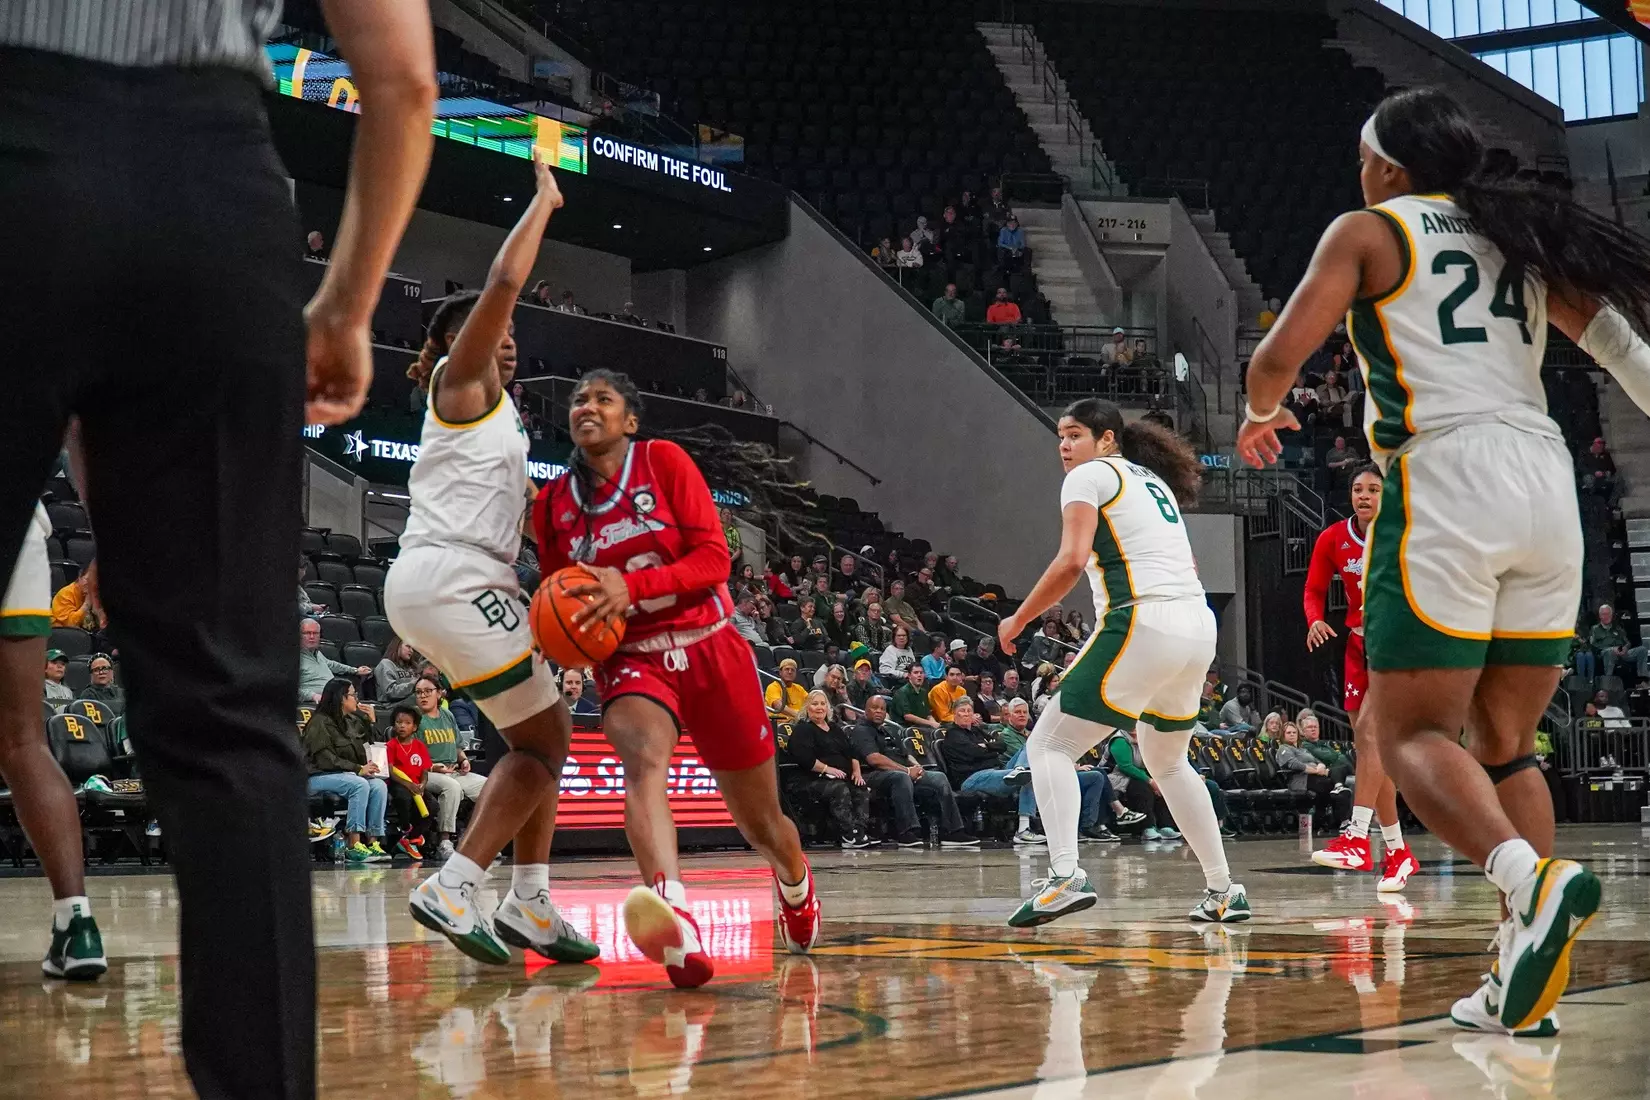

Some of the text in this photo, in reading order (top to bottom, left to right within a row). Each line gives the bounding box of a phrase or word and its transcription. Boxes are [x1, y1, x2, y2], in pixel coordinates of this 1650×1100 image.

[593, 136, 732, 193] CONFIRM THE FOUL.
[1098, 217, 1117, 229] 217
[1127, 218, 1147, 230] 216
[403, 284, 421, 298] 119
[1431, 249, 1533, 346] 24
[712, 347, 726, 360] 118
[369, 439, 421, 463] TEXAS
[1145, 481, 1179, 524] 8
[64, 716, 85, 740] BU
